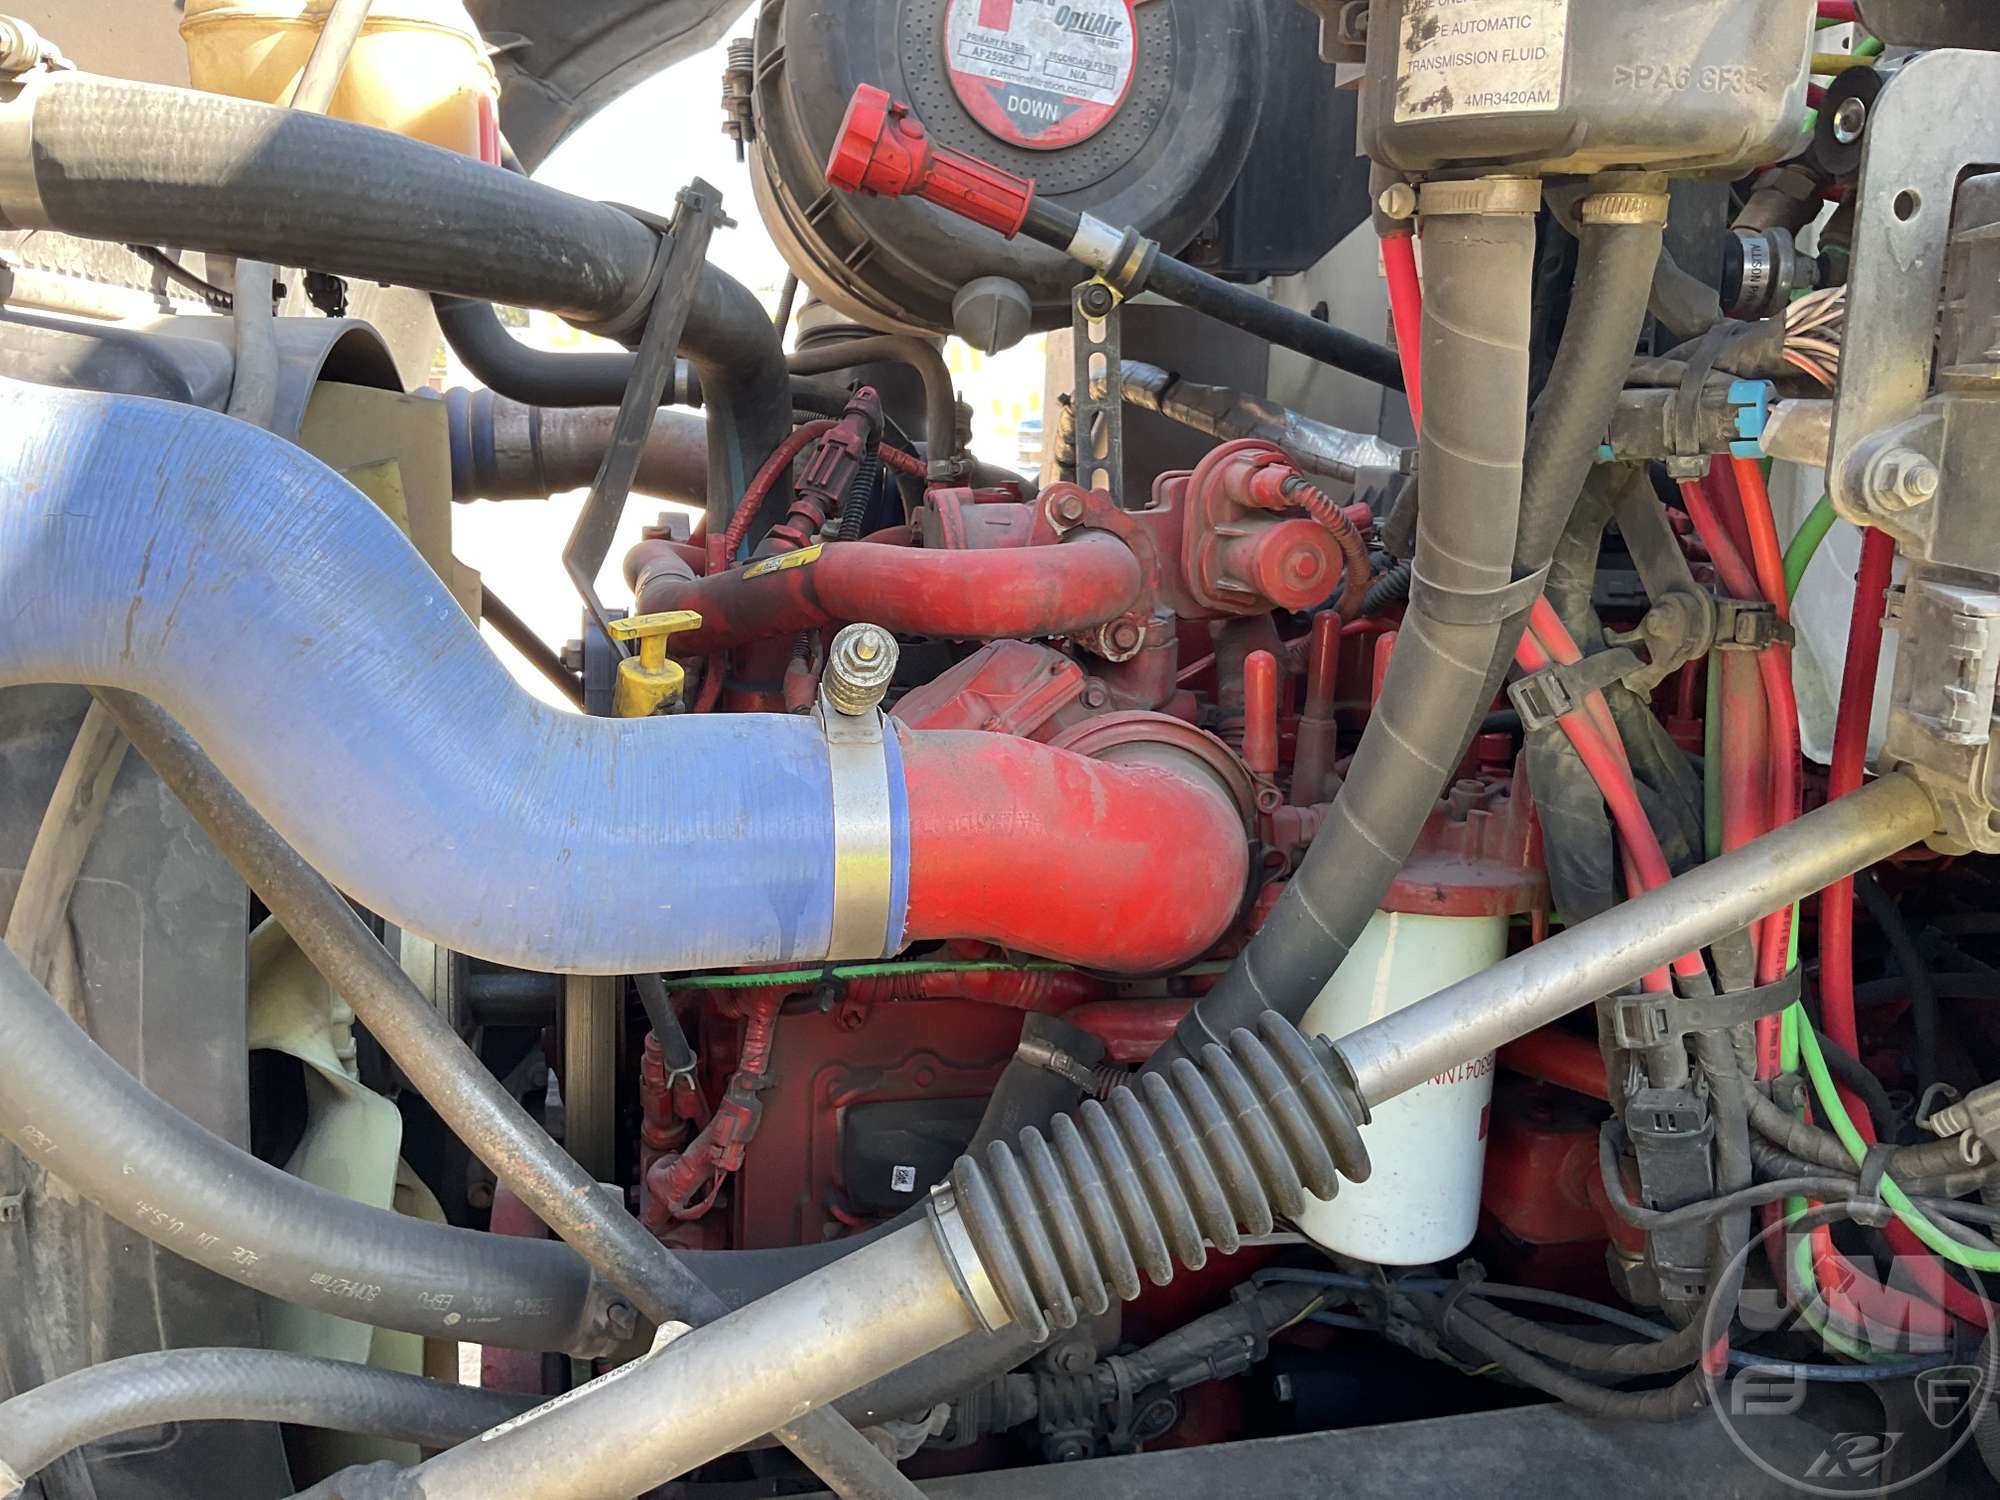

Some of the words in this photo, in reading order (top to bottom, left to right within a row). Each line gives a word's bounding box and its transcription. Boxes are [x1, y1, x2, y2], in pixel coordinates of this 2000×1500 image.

[1055, 5, 1122, 37] OptiAir
[1452, 15, 1532, 35] AUTOMATIC
[966, 32, 998, 46] PRIMARY
[998, 39, 1025, 52] FILTER
[972, 46, 1016, 65] AF25962
[1049, 51, 1092, 69] SECONDARY
[1093, 61, 1118, 73] FILTER
[1407, 51, 1498, 73] TRANSMISSION
[1502, 47, 1546, 63] FLUID
[1007, 95, 1059, 121] DOWN
[1464, 90, 1550, 107] 4MR3420AM
[1750, 243, 1762, 282] ALLISON
